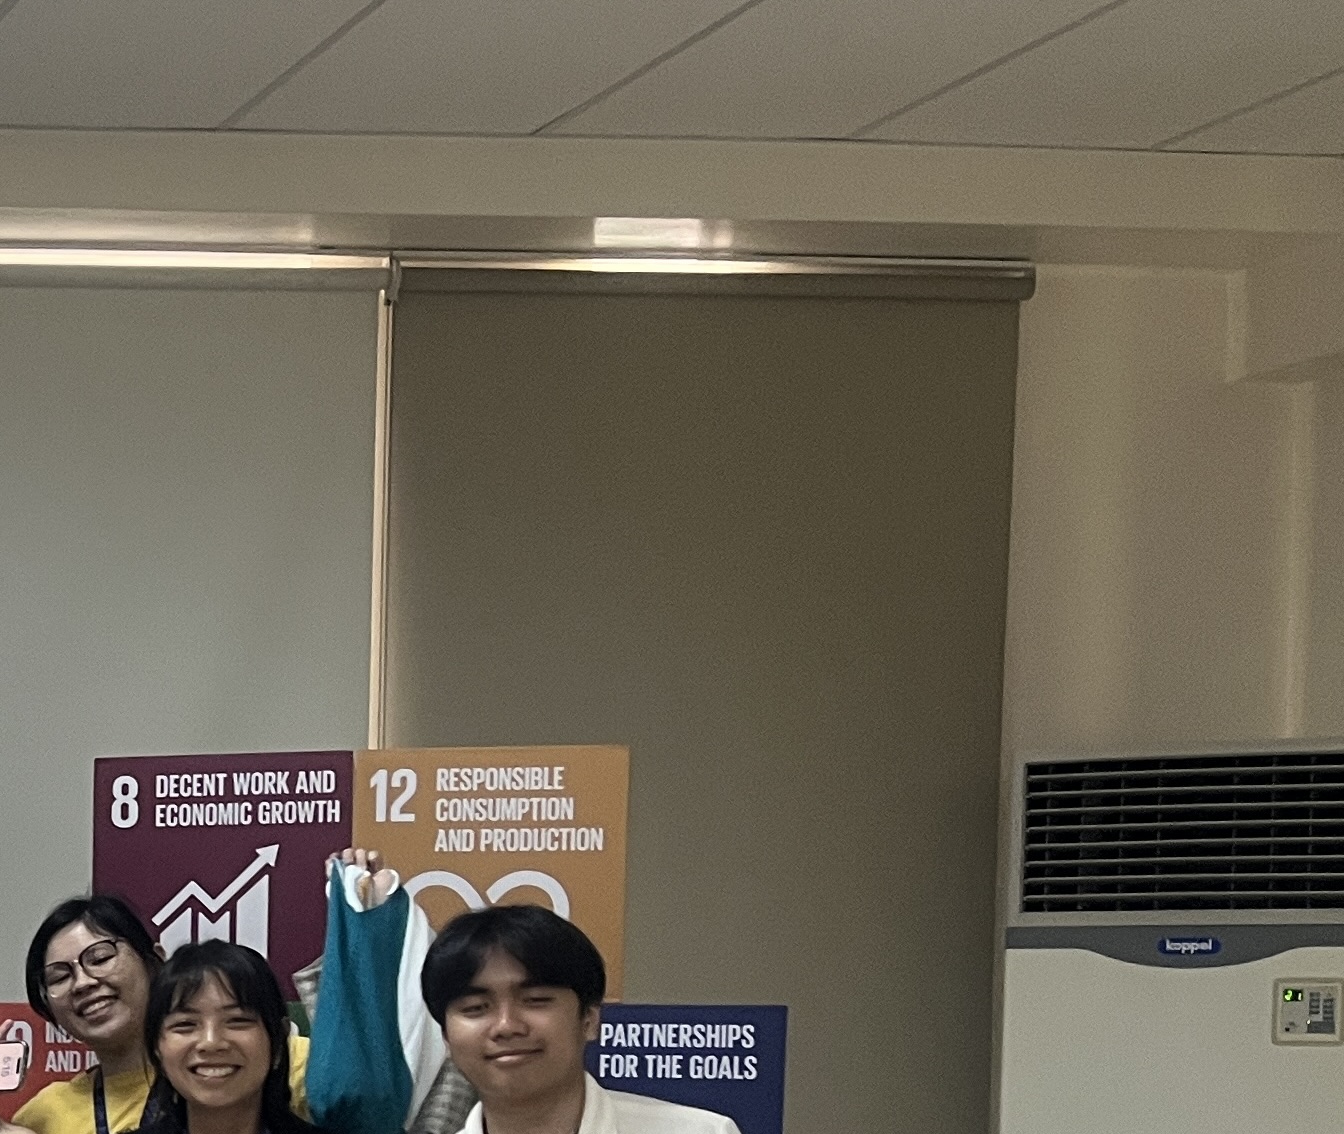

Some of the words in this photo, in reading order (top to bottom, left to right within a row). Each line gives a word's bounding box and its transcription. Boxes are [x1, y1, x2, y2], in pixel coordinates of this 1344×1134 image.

[155, 773, 227, 798] DECENT
[233, 771, 290, 796] WORK
[295, 770, 336, 794] AND
[436, 766, 565, 792] RESPONSIBLE
[111, 775, 139, 829] 8
[370, 768, 417, 823] 12
[155, 802, 252, 827] ECONOMIC
[258, 800, 341, 825] GROWTH
[435, 797, 574, 822] CONSUMPTION
[434, 828, 475, 852] AND
[480, 827, 604, 852] PRODUCTION
[1165, 938, 1213, 954] koppel
[600, 1024, 756, 1049] PARTNERSHIPS
[45, 1050, 81, 1073] AND
[599, 1054, 639, 1079] FOR
[645, 1055, 683, 1079] THE
[689, 1055, 758, 1080] GOALS
